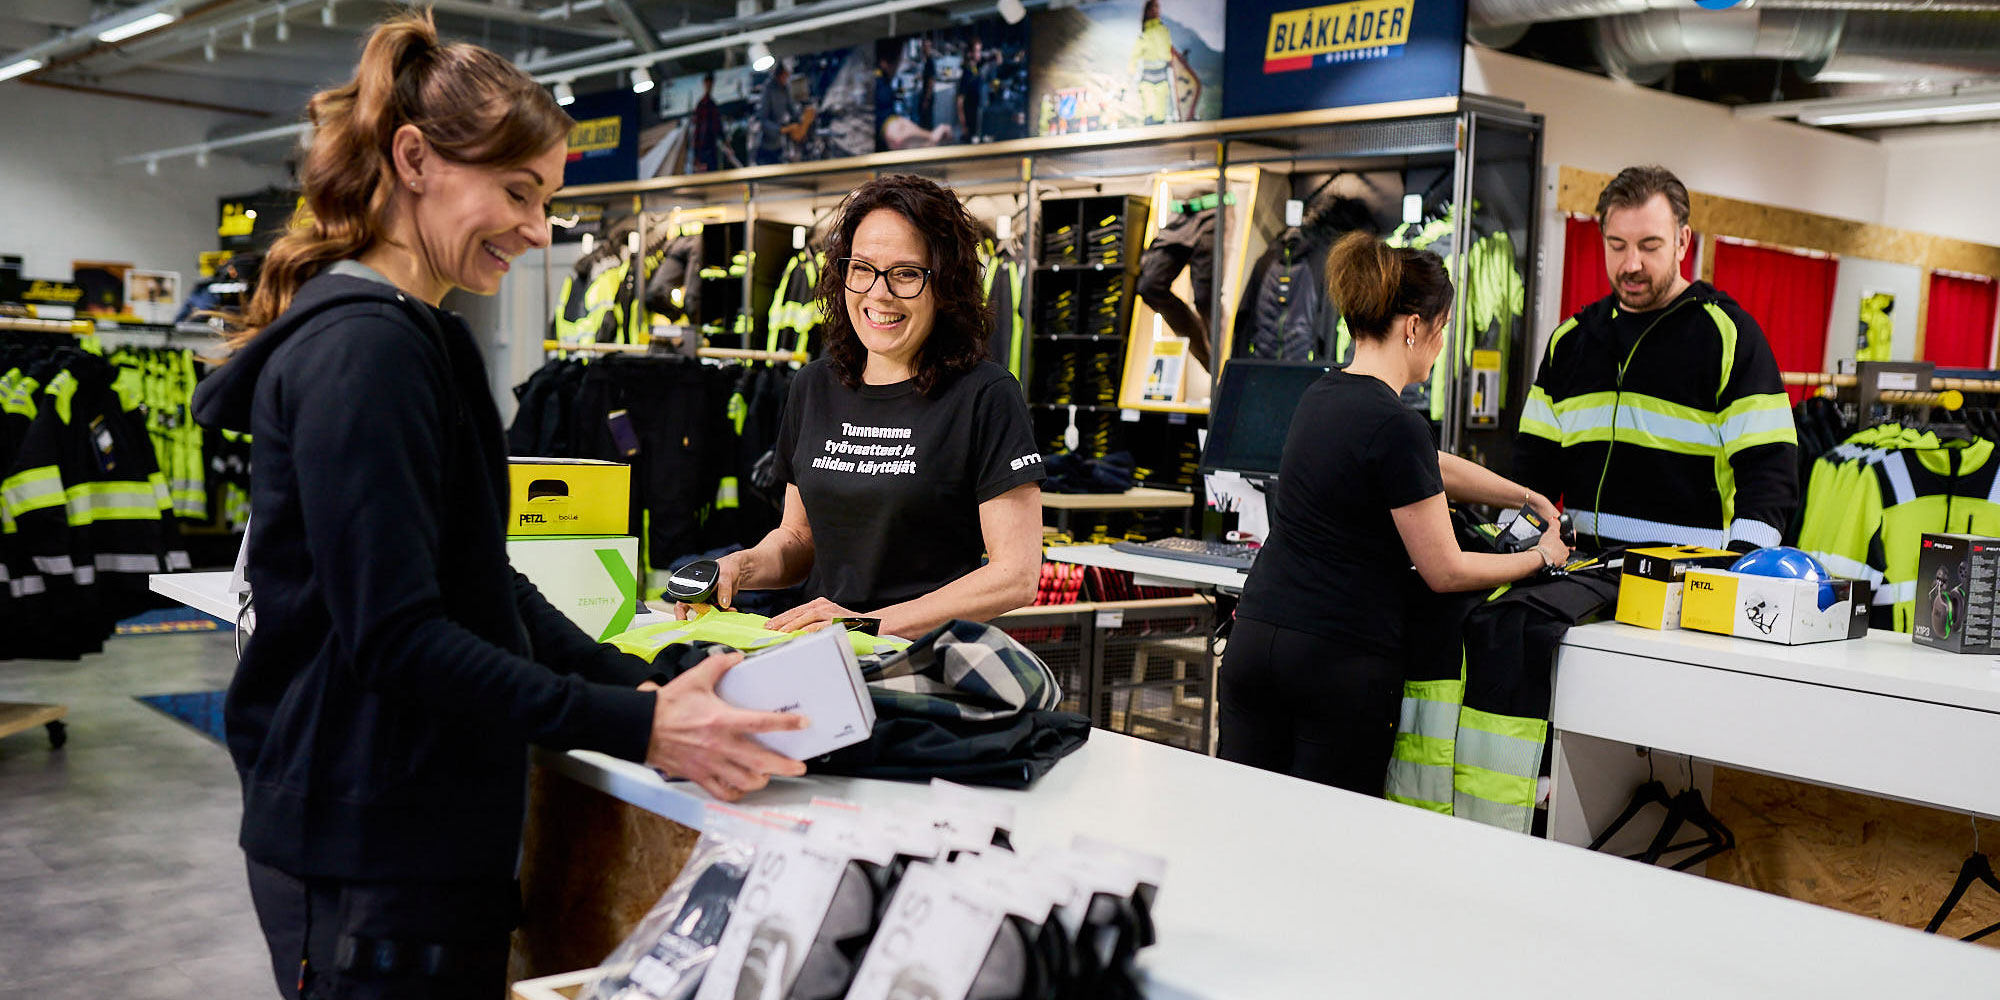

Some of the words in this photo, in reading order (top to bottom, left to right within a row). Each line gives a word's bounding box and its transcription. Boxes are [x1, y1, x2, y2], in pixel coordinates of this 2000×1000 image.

[1273, 5, 1405, 53] BLÅKLÄDER
[841, 422, 912, 439] Tunnemme
[824, 440, 902, 456] työvaatteet
[901, 444, 917, 459] ja
[811, 456, 856, 472] niiden
[856, 460, 917, 476] käyttäjät
[519, 514, 548, 526] PETZL
[1690, 580, 1714, 592] PETZL
[577, 597, 609, 607] ZENITH
